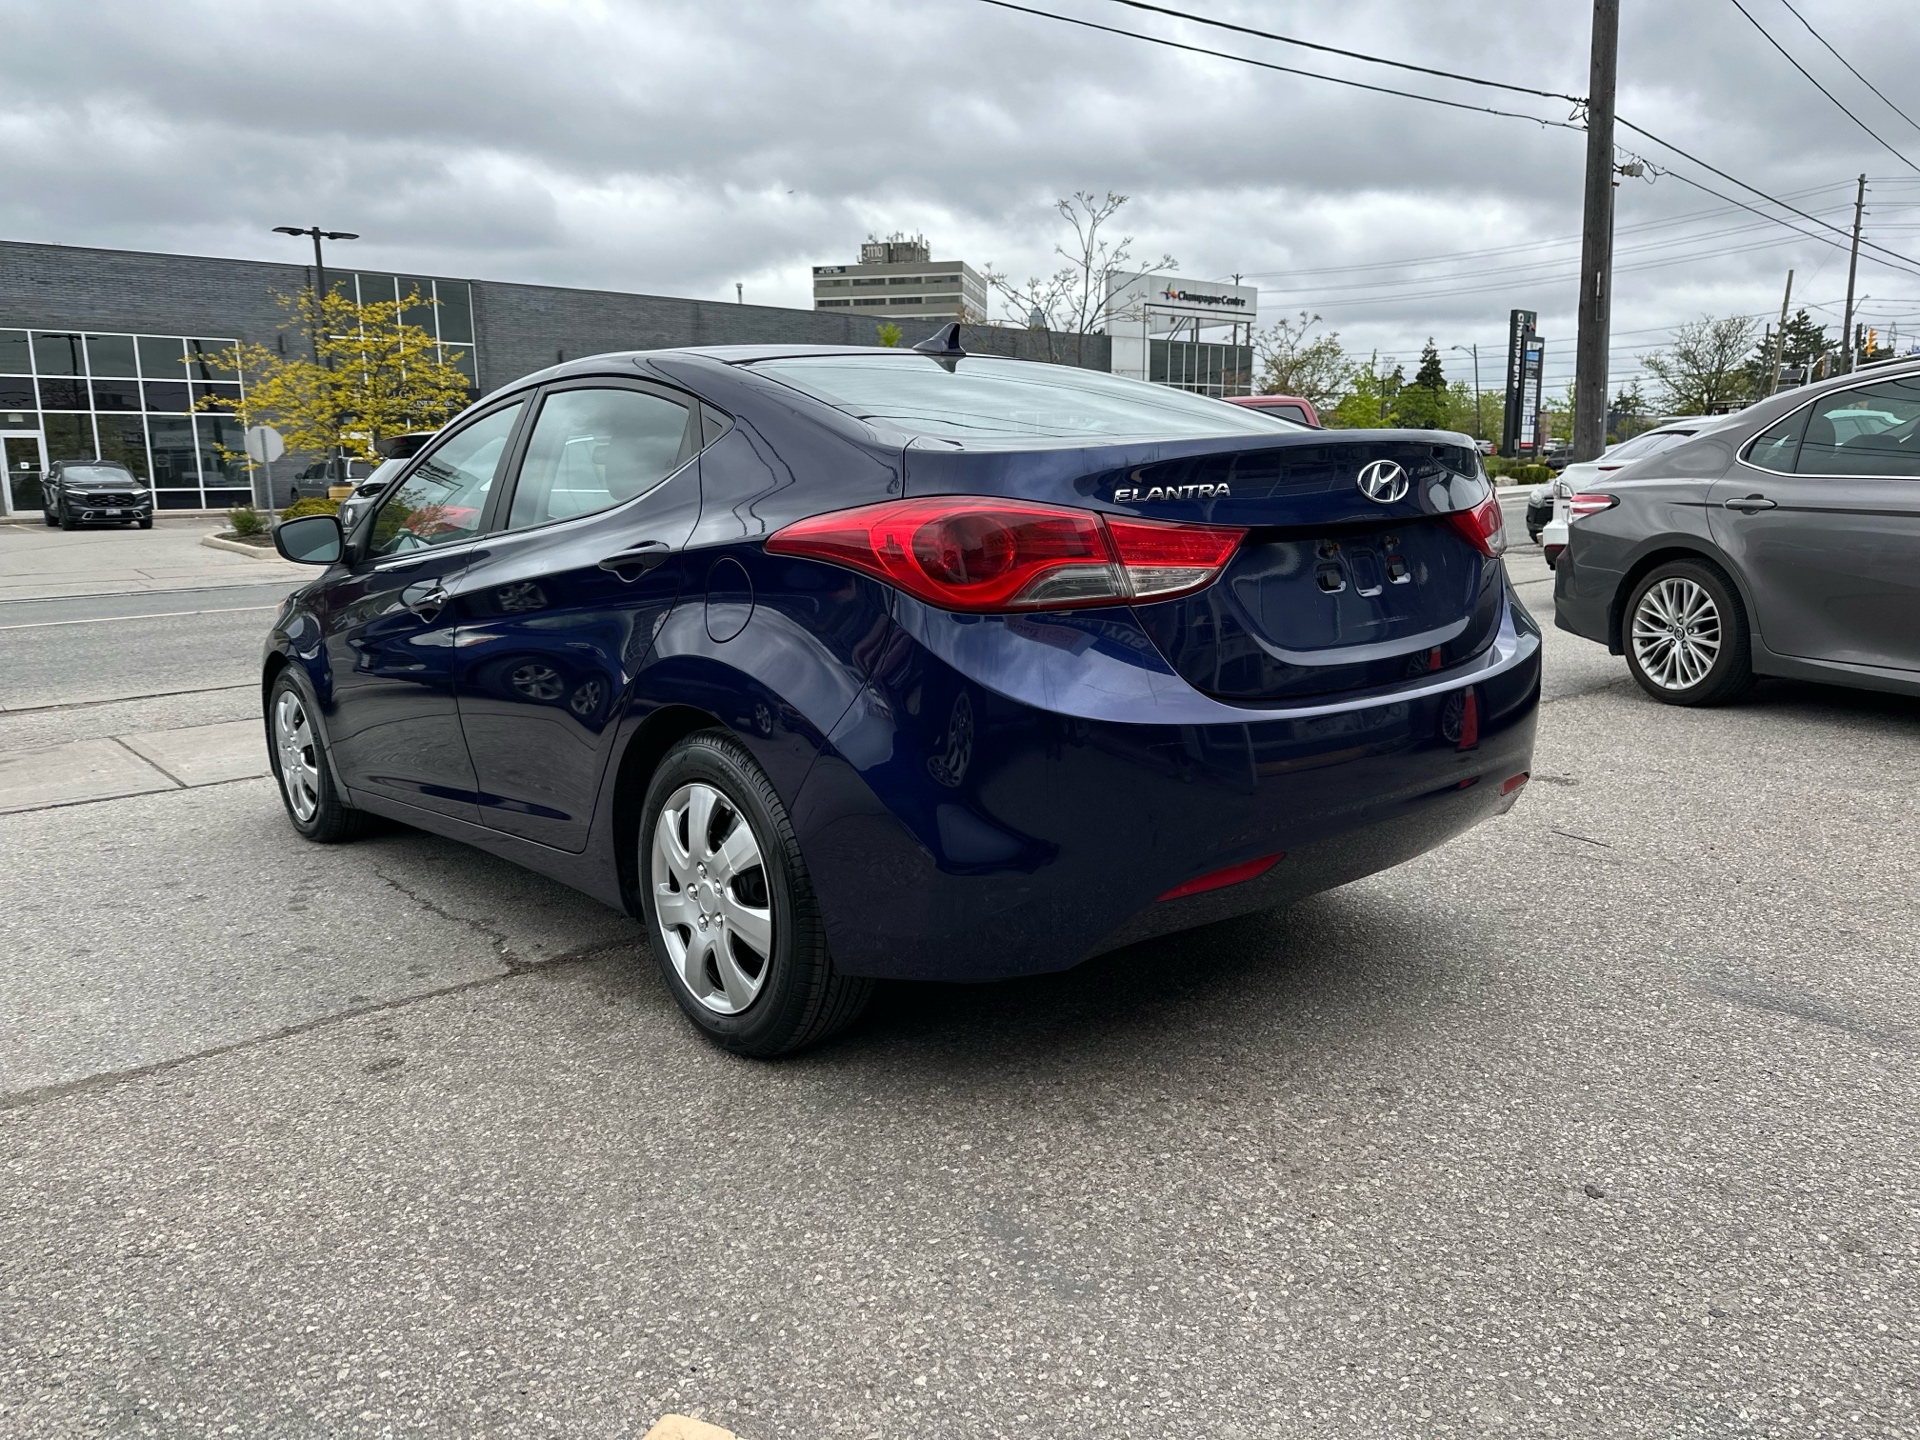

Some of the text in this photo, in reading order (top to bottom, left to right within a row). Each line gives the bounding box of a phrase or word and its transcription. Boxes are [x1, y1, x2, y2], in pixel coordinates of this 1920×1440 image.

[866, 246, 883, 258] 1110
[1178, 291, 1246, 307] Champagne Centre
[1513, 313, 1524, 389] Champagne
[1113, 482, 1231, 504] ELANTRA
